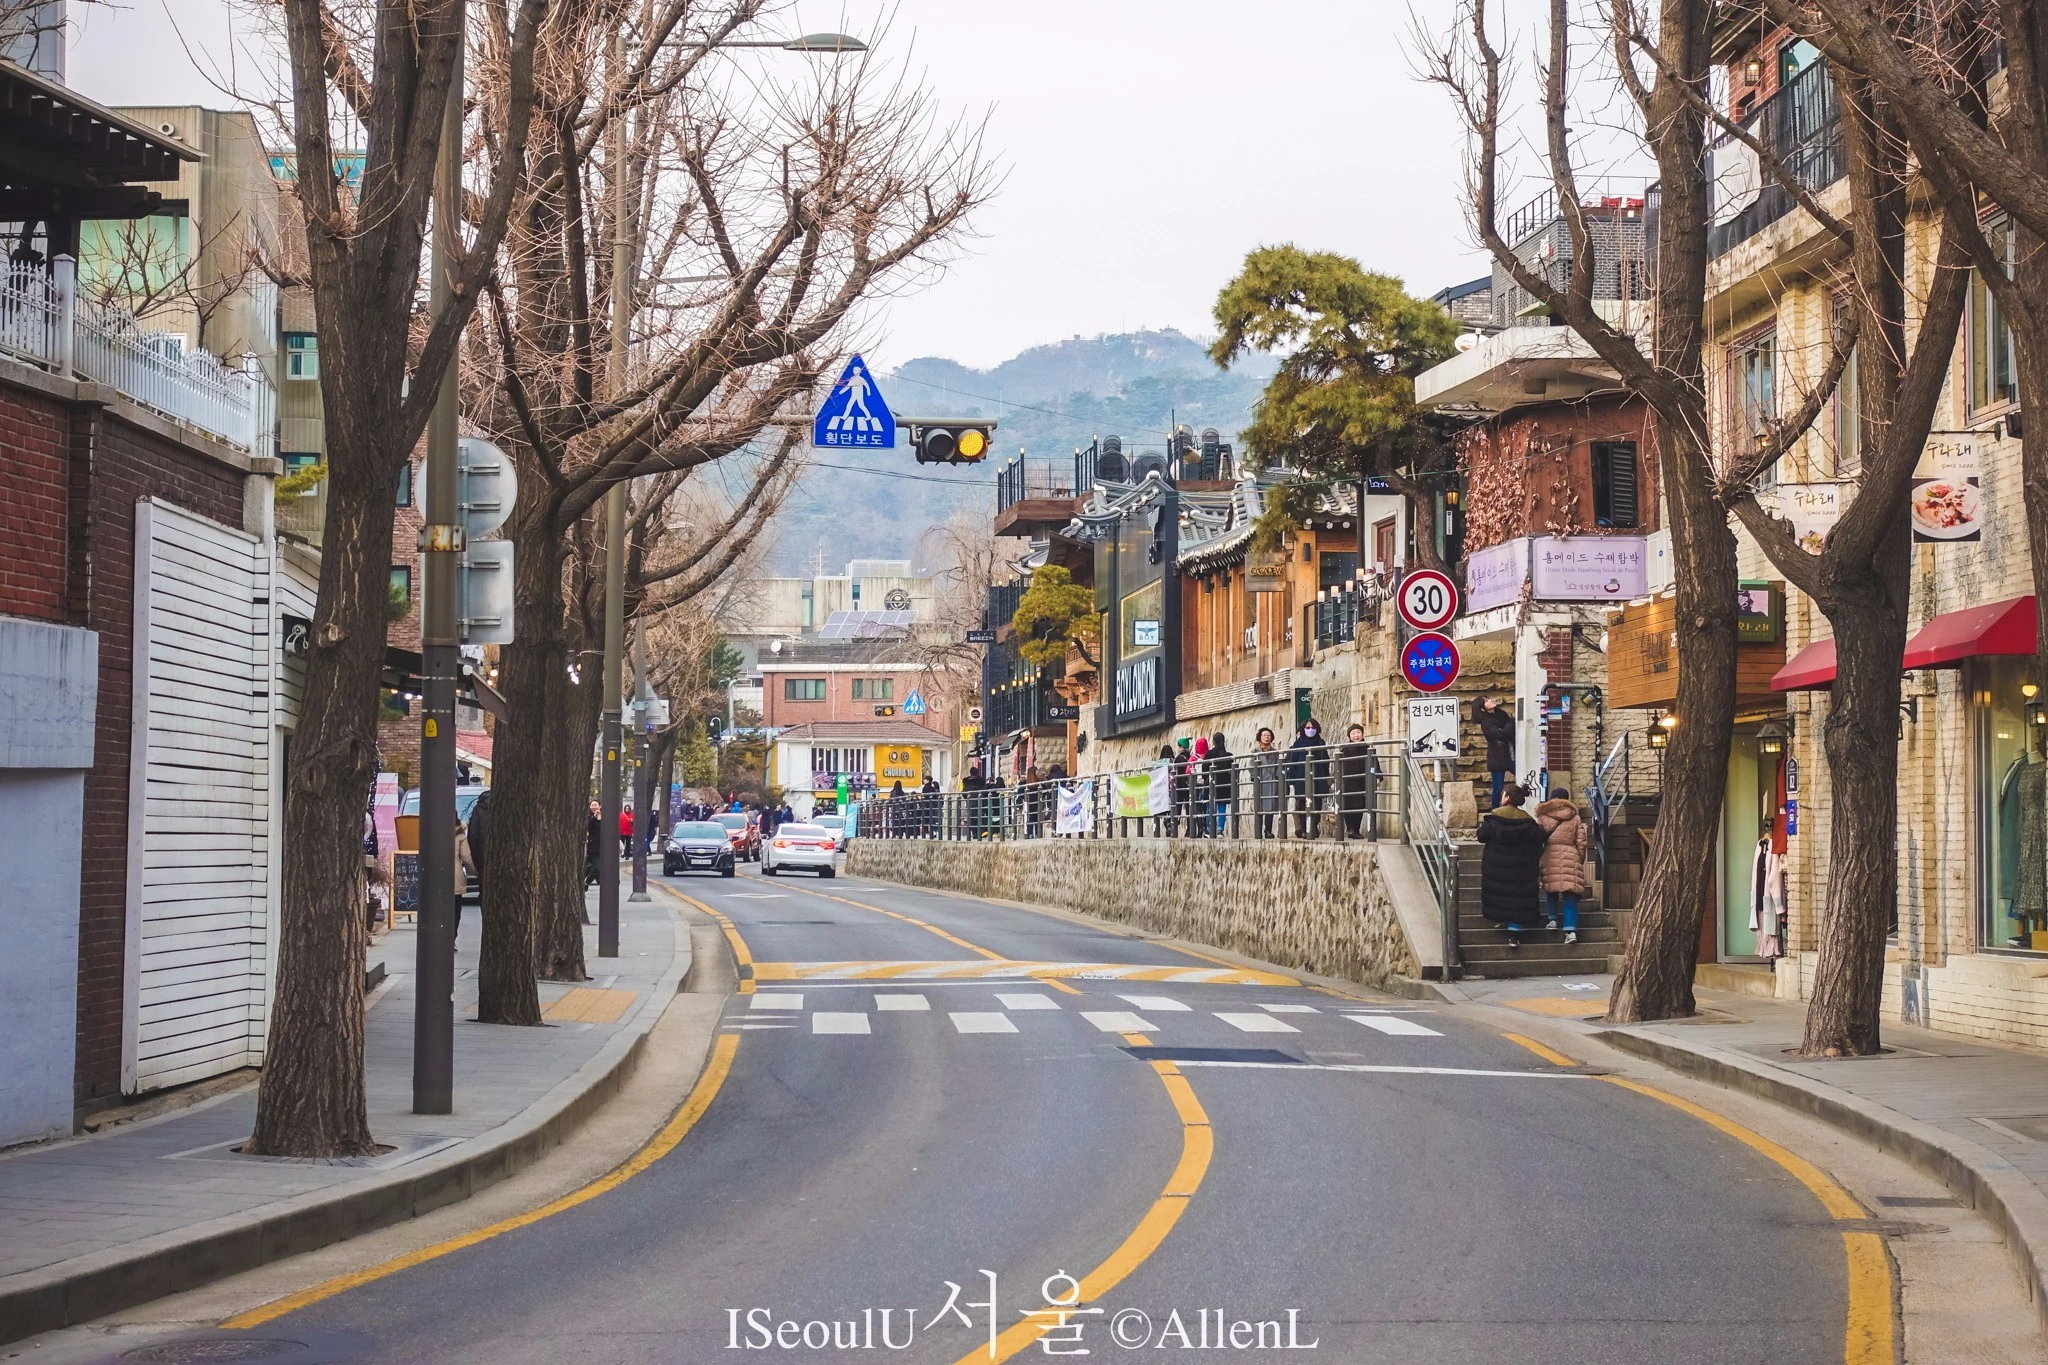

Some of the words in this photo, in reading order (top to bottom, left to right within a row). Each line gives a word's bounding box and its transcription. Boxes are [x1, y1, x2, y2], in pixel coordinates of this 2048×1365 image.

[825, 432, 883, 445] 횡단보도
[1542, 551, 1588, 564] 홈메이드
[1594, 551, 1640, 564] 수제함박
[1413, 585, 1443, 615] 30
[1410, 656, 1452, 668] 주정차금지
[1412, 704, 1455, 717] 견인지역
